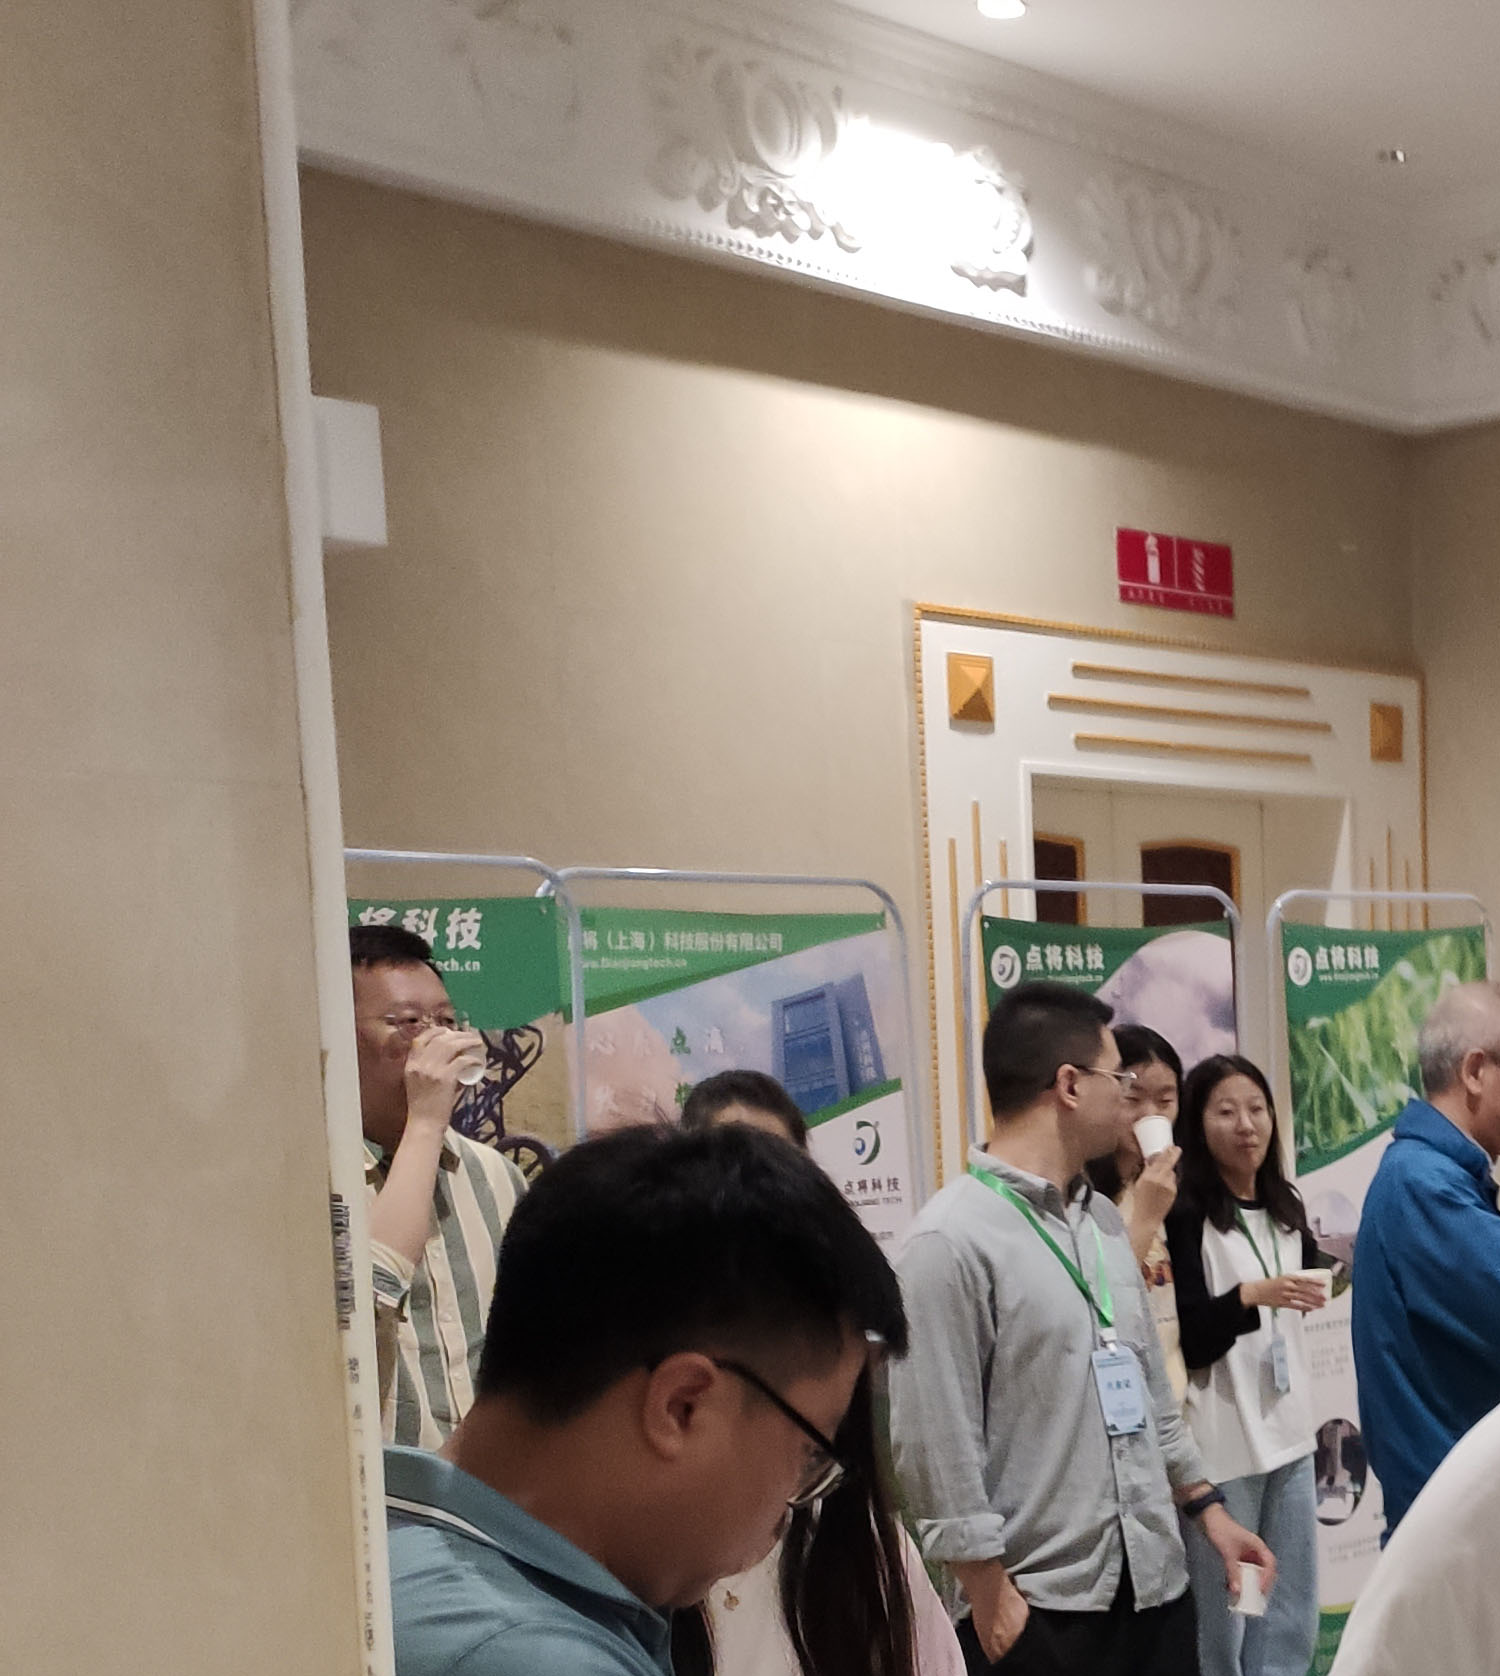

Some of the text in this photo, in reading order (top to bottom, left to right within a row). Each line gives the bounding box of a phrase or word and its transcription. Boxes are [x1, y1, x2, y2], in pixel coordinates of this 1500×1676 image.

[1026, 943, 1104, 971] 点将科技
[1315, 944, 1379, 970] 点将科技
